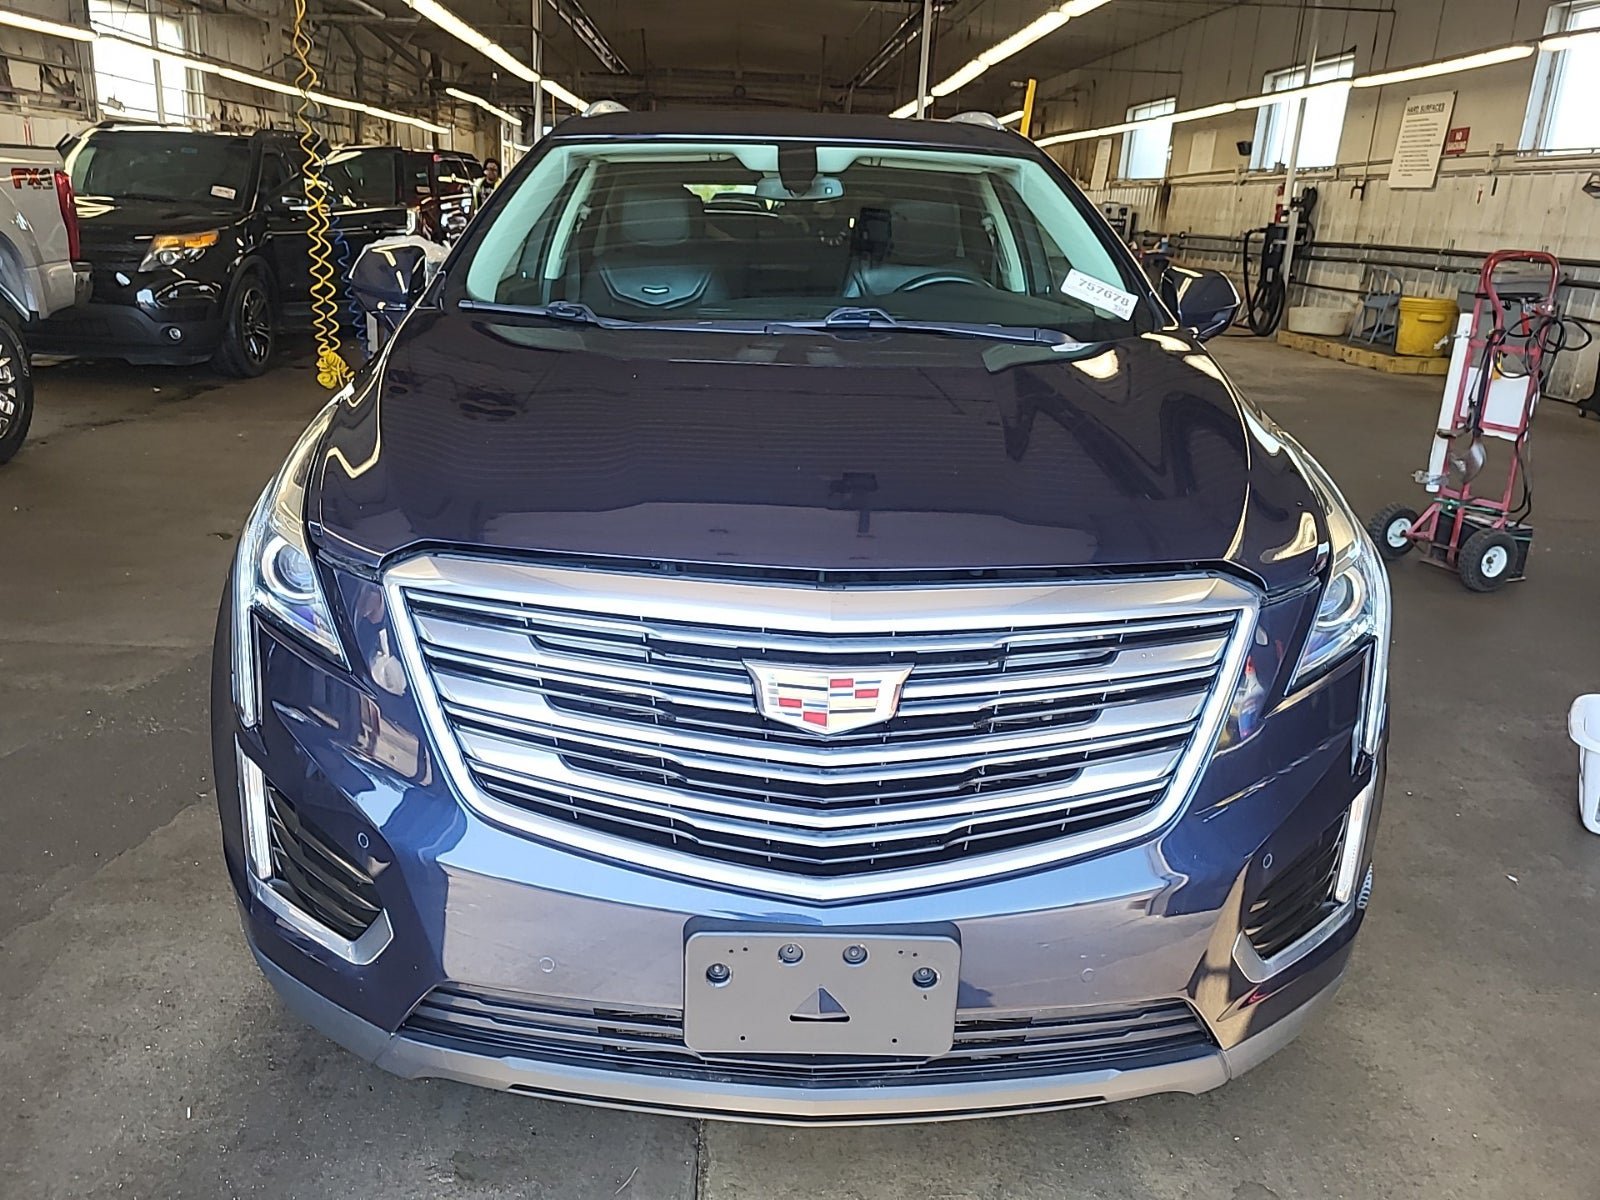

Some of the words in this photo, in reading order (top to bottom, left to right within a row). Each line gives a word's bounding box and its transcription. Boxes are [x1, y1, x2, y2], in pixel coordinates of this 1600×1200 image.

[1407, 105, 1419, 113] HARD
[11, 168, 52, 189] FX4
[1079, 278, 1130, 307] 757678
